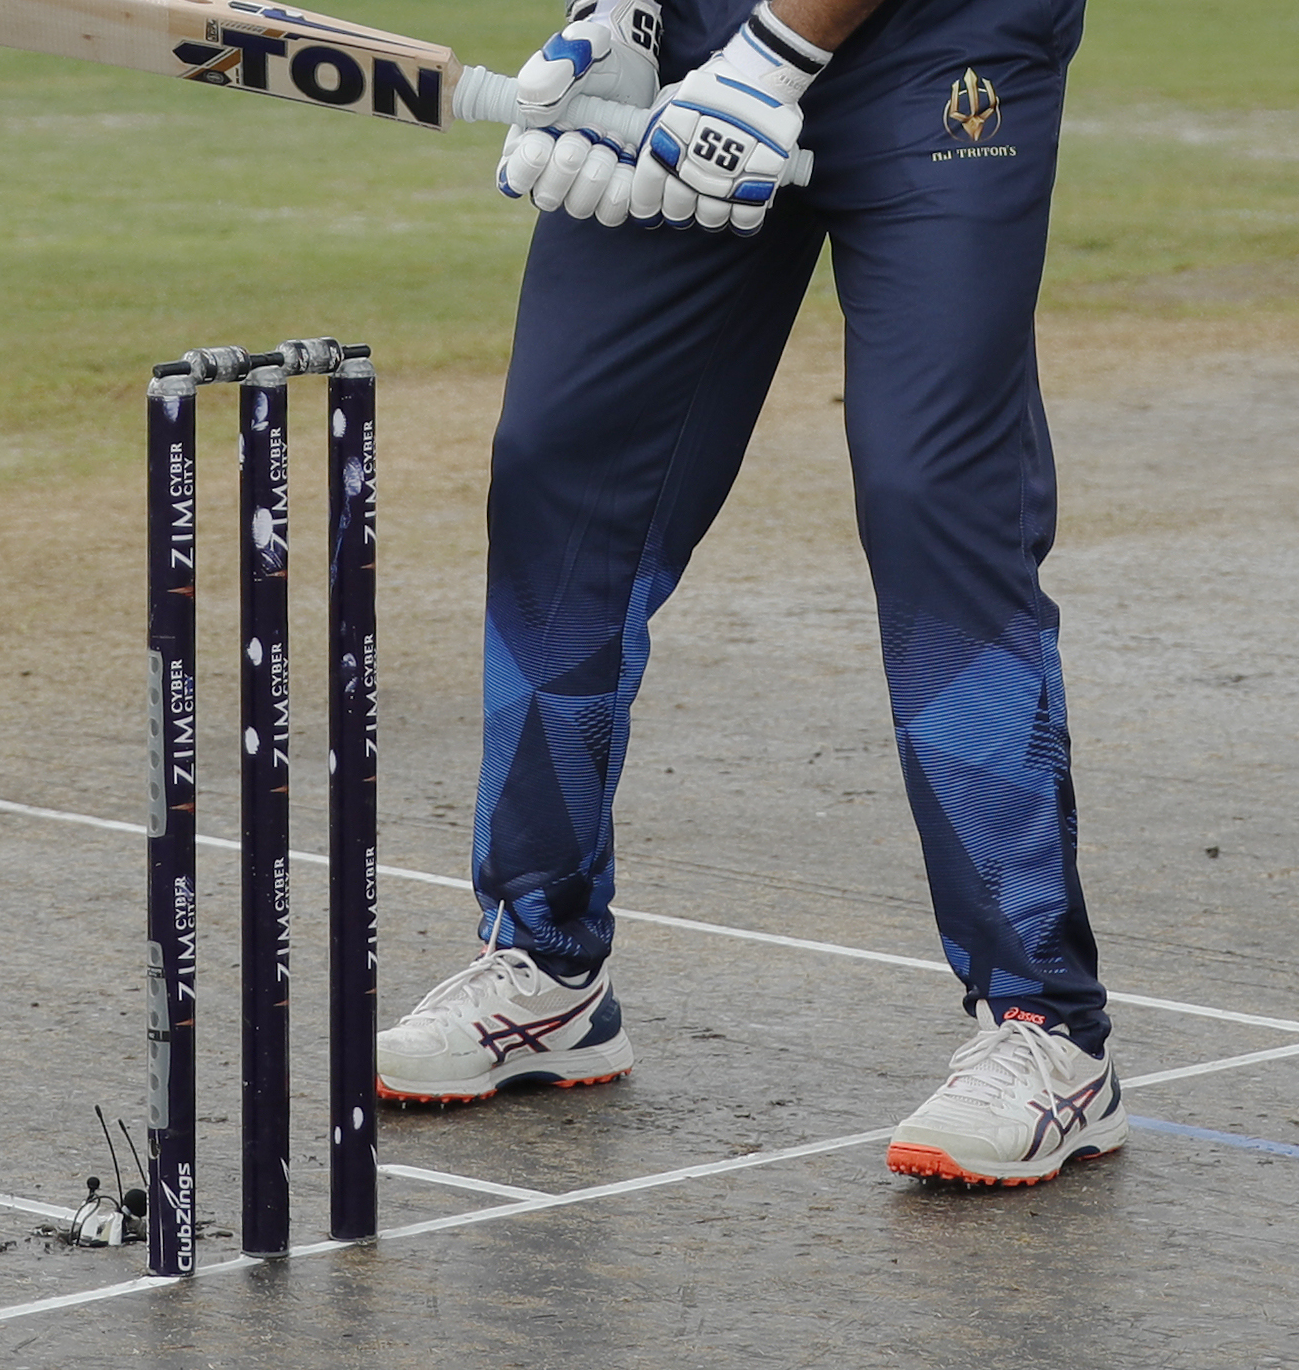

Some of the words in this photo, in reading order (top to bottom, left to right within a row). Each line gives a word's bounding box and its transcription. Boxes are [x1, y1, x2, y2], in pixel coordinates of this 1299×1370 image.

[222, 28, 442, 127] TON
[693, 126, 745, 171] SS
[170, 442, 183, 497] CYBER
[269, 427, 281, 481] CYBER
[363, 420, 374, 474] CYBER
[184, 457, 194, 495] CITY
[171, 498, 194, 569] ZIM
[171, 659, 183, 713] CYBER
[271, 642, 283, 697] CYBER
[363, 633, 374, 688] CYBER
[173, 714, 195, 785] ZIM
[274, 857, 285, 911] CYBER
[365, 846, 376, 900] CYBER
[178, 932, 196, 1001] ZIM
[1017, 1010, 1046, 1025] asics
[175, 1162, 194, 1272] ClubZings
